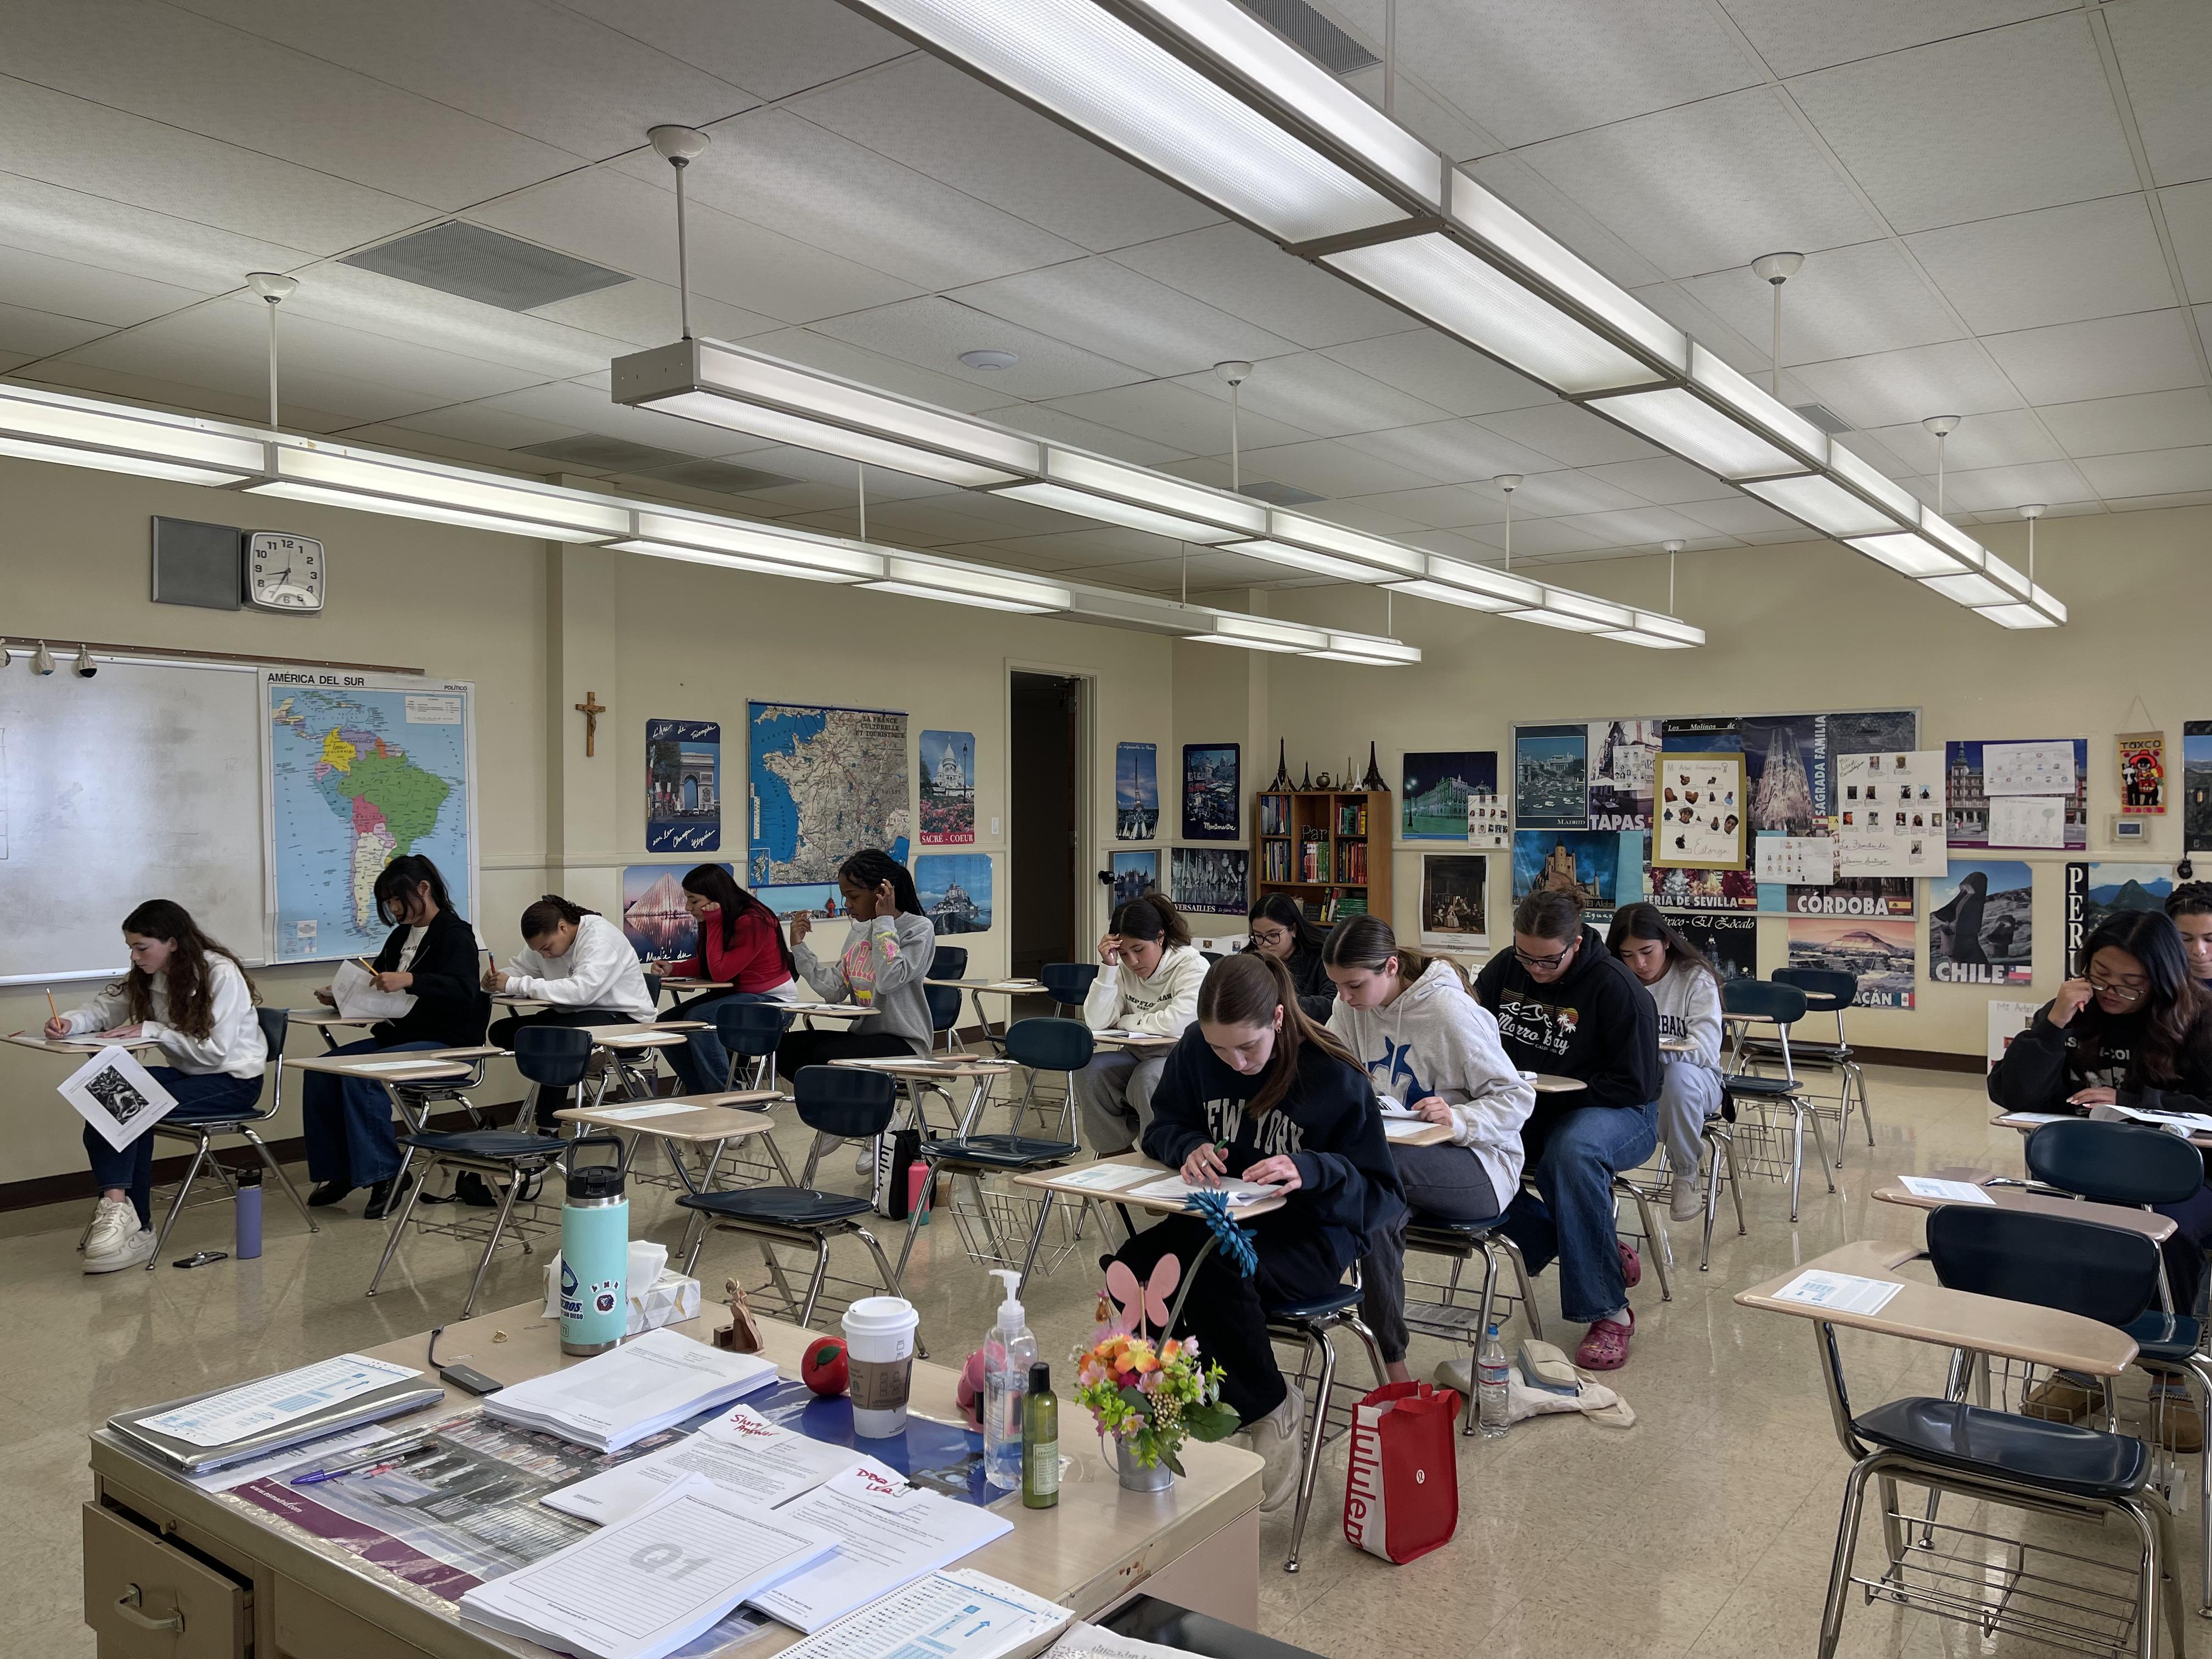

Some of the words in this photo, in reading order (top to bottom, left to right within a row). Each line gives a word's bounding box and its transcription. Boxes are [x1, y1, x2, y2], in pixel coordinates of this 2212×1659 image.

[267, 541, 277, 550] 11
[281, 540, 294, 548] 12
[256, 550, 267, 558] 10
[306, 585, 314, 594] 4
[268, 672, 315, 684] AMÉRICA
[319, 675, 340, 685] DEL
[344, 677, 364, 686] SUR
[677, 725, 686, 735] de
[861, 723, 900, 731] CULTURELLE
[866, 731, 905, 739] TOURISTIQUE
[1815, 715, 1826, 759] FAMILIA
[1815, 763, 1826, 816] SAGRADA
[1204, 822, 1236, 831] Montmartre
[1589, 814, 1645, 830] TAPAS
[922, 833, 943, 843] SACRÉ
[950, 834, 973, 843] COEUR
[1644, 895, 1673, 905] FERIA
[1677, 895, 1690, 906] DE
[1694, 896, 1739, 907] SEVILLA
[1797, 891, 1889, 915] CÓRDOBA
[1174, 904, 1216, 912] VERSAILLES
[1585, 911, 1613, 922] Iguaz
[1662, 915, 1685, 927] xico
[1691, 916, 1712, 928] El
[1936, 962, 2005, 984] CHILE
[1125, 994, 1140, 1004] AMP
[1157, 993, 1172, 1002] NAW
[1852, 989, 1892, 1006] ACÁN
[1498, 1012, 1539, 1040] Morro
[1543, 1028, 1570, 1055] Bay
[1203, 1098, 1245, 1143] EW
[561, 1299, 582, 1312] EROS
[1346, 1424, 1379, 1548] lululem
[629, 1542, 713, 1581] Q1
